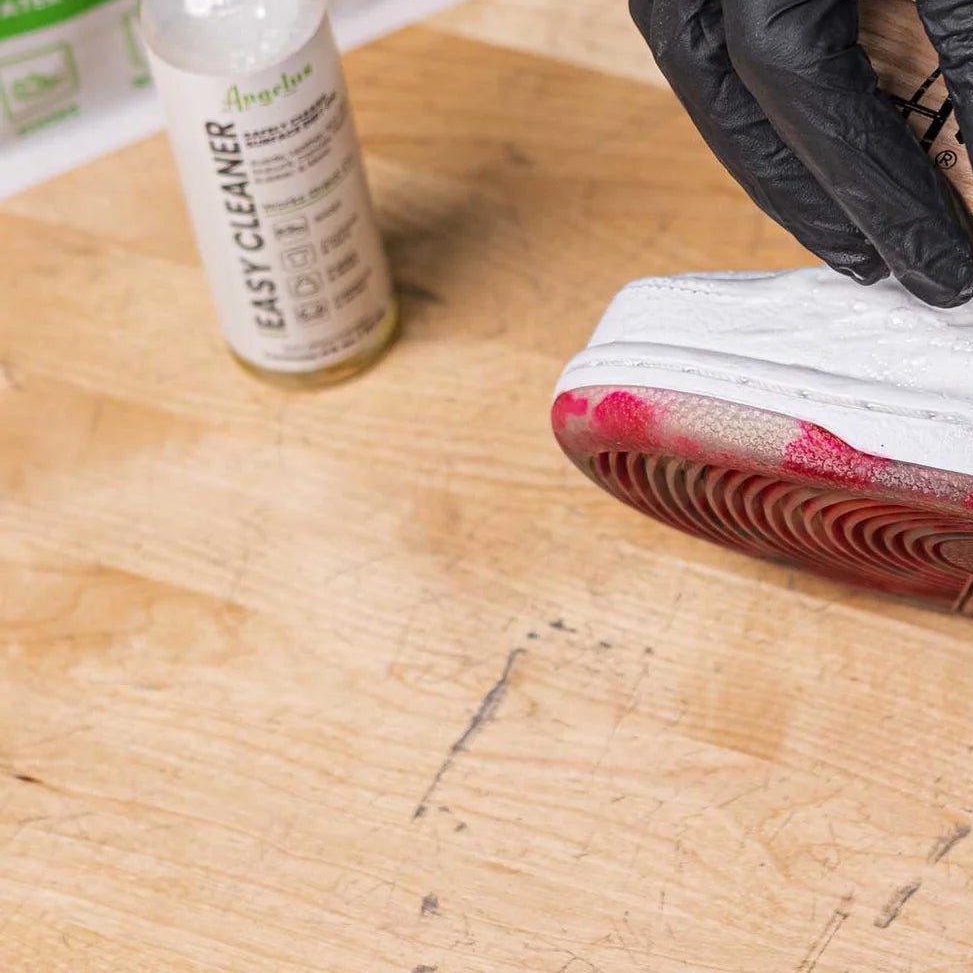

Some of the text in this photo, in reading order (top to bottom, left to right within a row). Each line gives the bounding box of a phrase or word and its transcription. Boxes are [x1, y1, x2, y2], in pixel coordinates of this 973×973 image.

[222, 63, 313, 113] Angelus
[204, 120, 287, 330] EASY CLEANER
